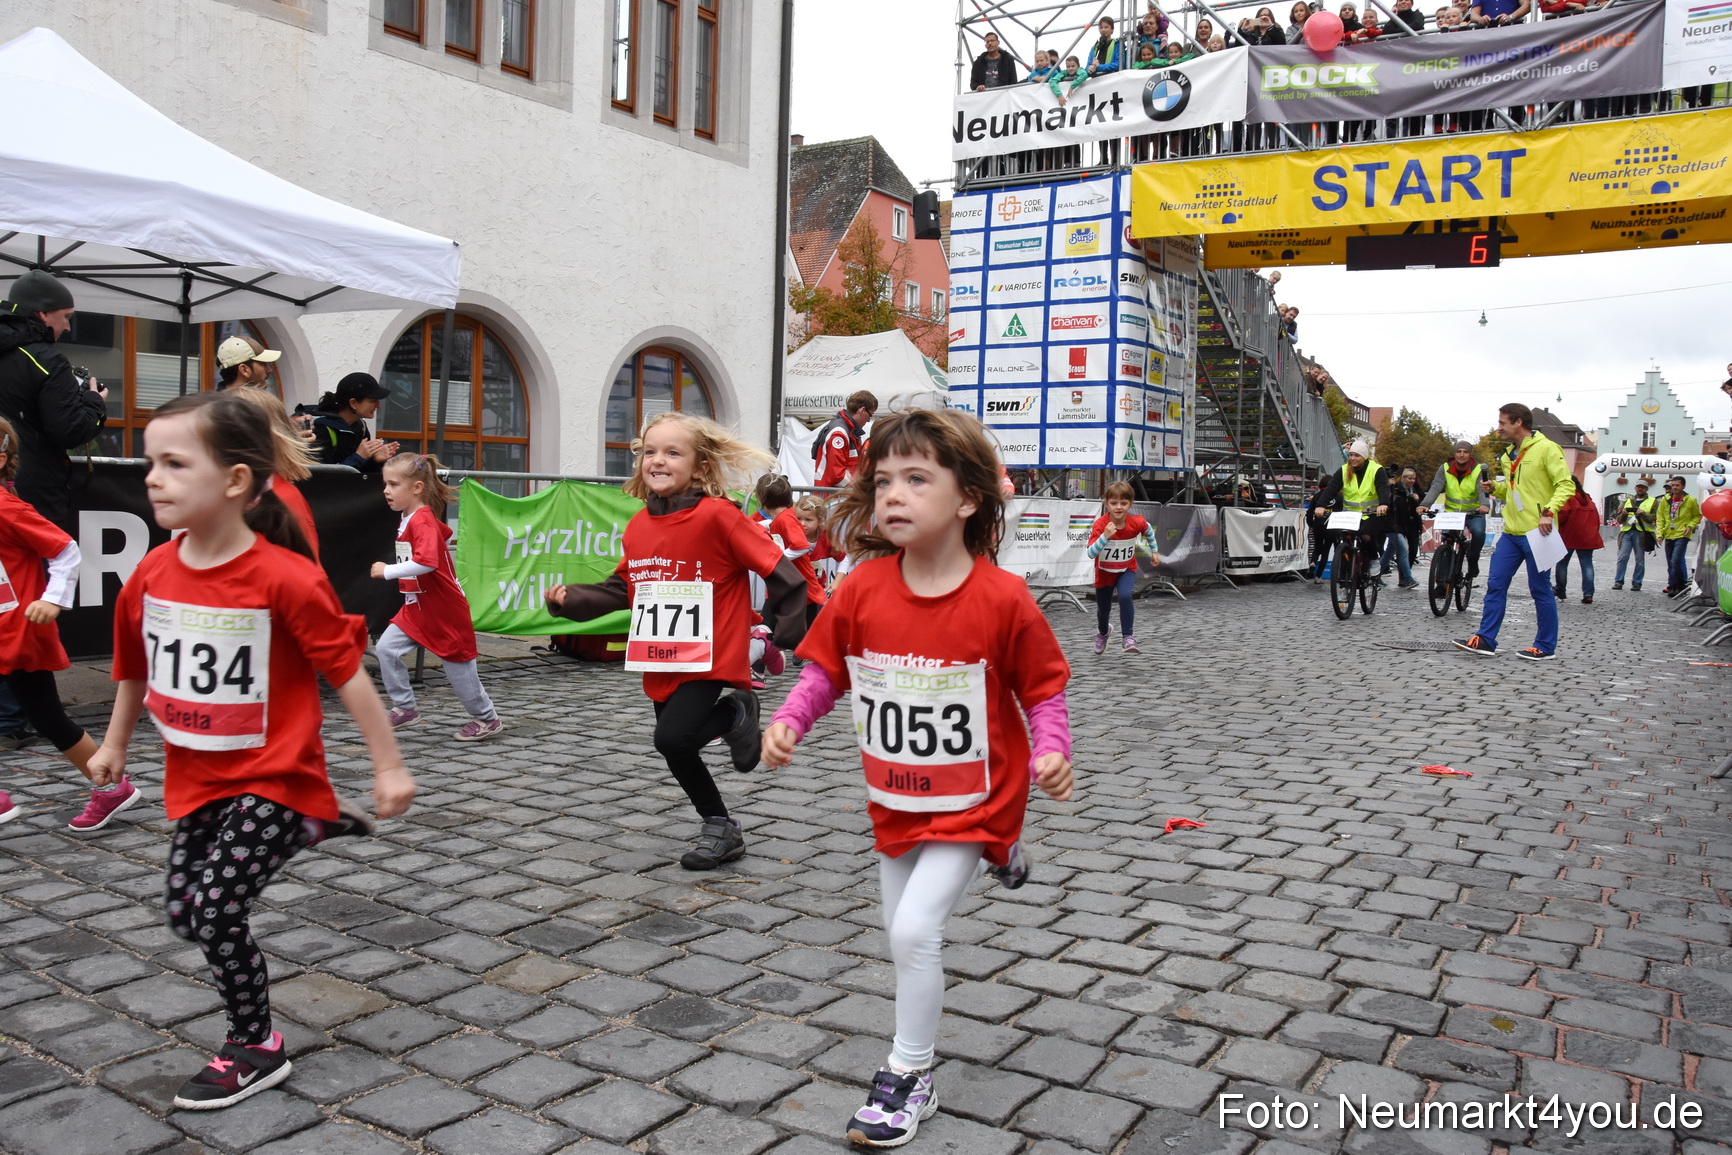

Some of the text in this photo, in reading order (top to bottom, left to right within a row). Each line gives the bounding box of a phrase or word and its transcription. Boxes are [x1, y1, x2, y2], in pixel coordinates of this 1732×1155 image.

[1402, 32, 1638, 75] OFFICE INDUSTRY LOUNGE
[1145, 71, 1189, 91] BMW
[1262, 64, 1378, 90] BOCK
[1433, 58, 1599, 90] www.bockonline.de
[1260, 88, 1379, 101] inspired by smart concepts
[1568, 156, 1728, 183] Neumarkter Stadtlauf
[1311, 148, 1527, 212] START
[1024, 199, 1041, 207] CODE
[1024, 205, 1044, 213] CLINIC
[1058, 199, 1095, 209] RAIL.ONE
[1159, 194, 1278, 211] Neumarkter Stadtlauf
[1590, 208, 1727, 230] Neumarkter Stadtlauf
[1227, 236, 1332, 249] Neumarkter Stadtlauf
[1469, 235, 1488, 264] 6
[1004, 281, 1042, 291] VARIOTEC
[1057, 412, 1096, 420] Lammsbräu
[1000, 444, 1037, 452] VARIOTEC
[1610, 457, 1643, 467] BMW
[1645, 458, 1703, 470] Laufsport
[504, 519, 624, 559] Herzlich
[1015, 531, 1051, 541] NeuerMarkt
[1104, 546, 1134, 560] 7415
[628, 556, 672, 569] Neumarkter
[630, 569, 662, 581] Stadtlauf
[657, 585, 703, 596] BOCK
[181, 609, 256, 631] BOCK
[636, 603, 700, 637] 7171
[648, 646, 677, 659] Eleni
[147, 632, 255, 695] 7134
[895, 671, 970, 691] BOCK
[165, 703, 211, 730] Greta
[859, 694, 973, 757] 7053
[885, 768, 931, 792] Julia
